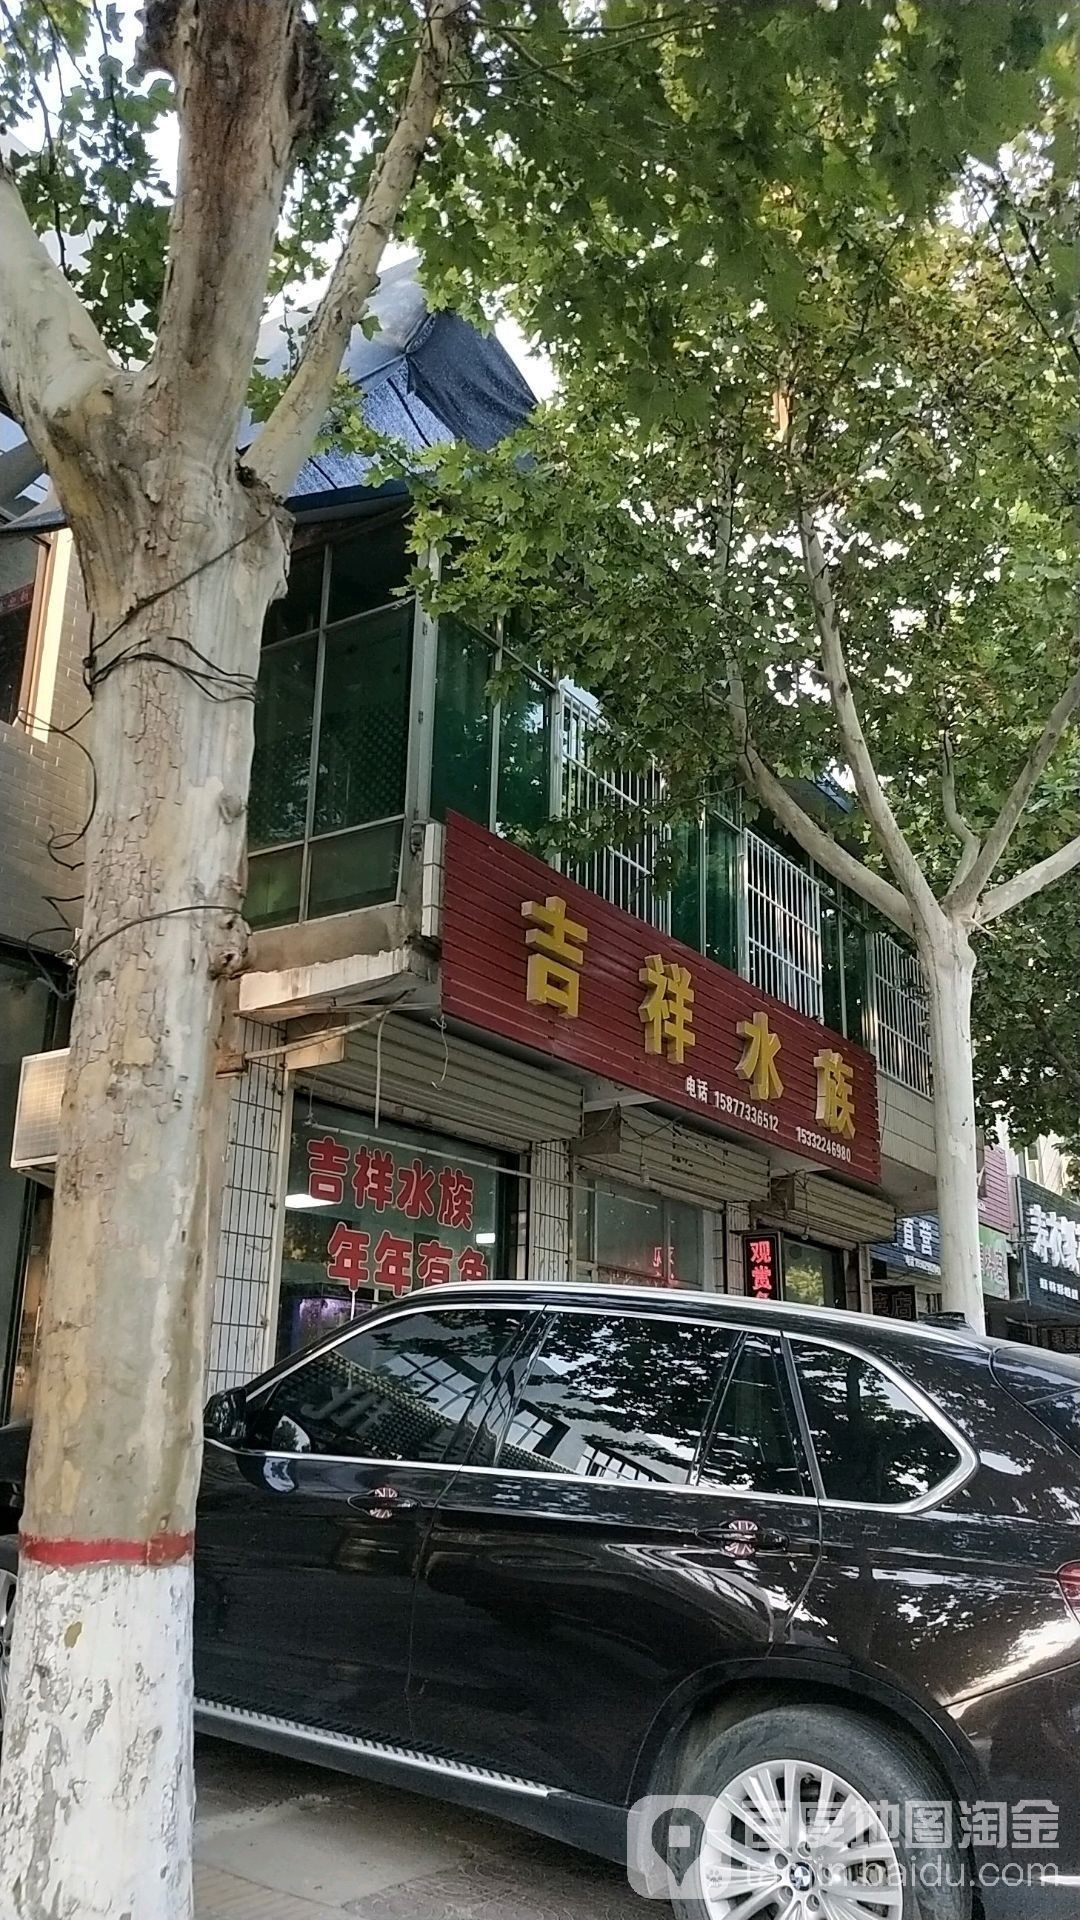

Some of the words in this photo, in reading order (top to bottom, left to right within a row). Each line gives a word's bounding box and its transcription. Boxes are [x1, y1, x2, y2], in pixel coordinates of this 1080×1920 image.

[521, 896, 856, 1139] 吉祥水族
[685, 1075, 709, 1104] 电话
[714, 1091, 779, 1133] 15877336512
[795, 1126, 852, 1163] 15332246980
[307, 1135, 474, 1231] 吉祥水族
